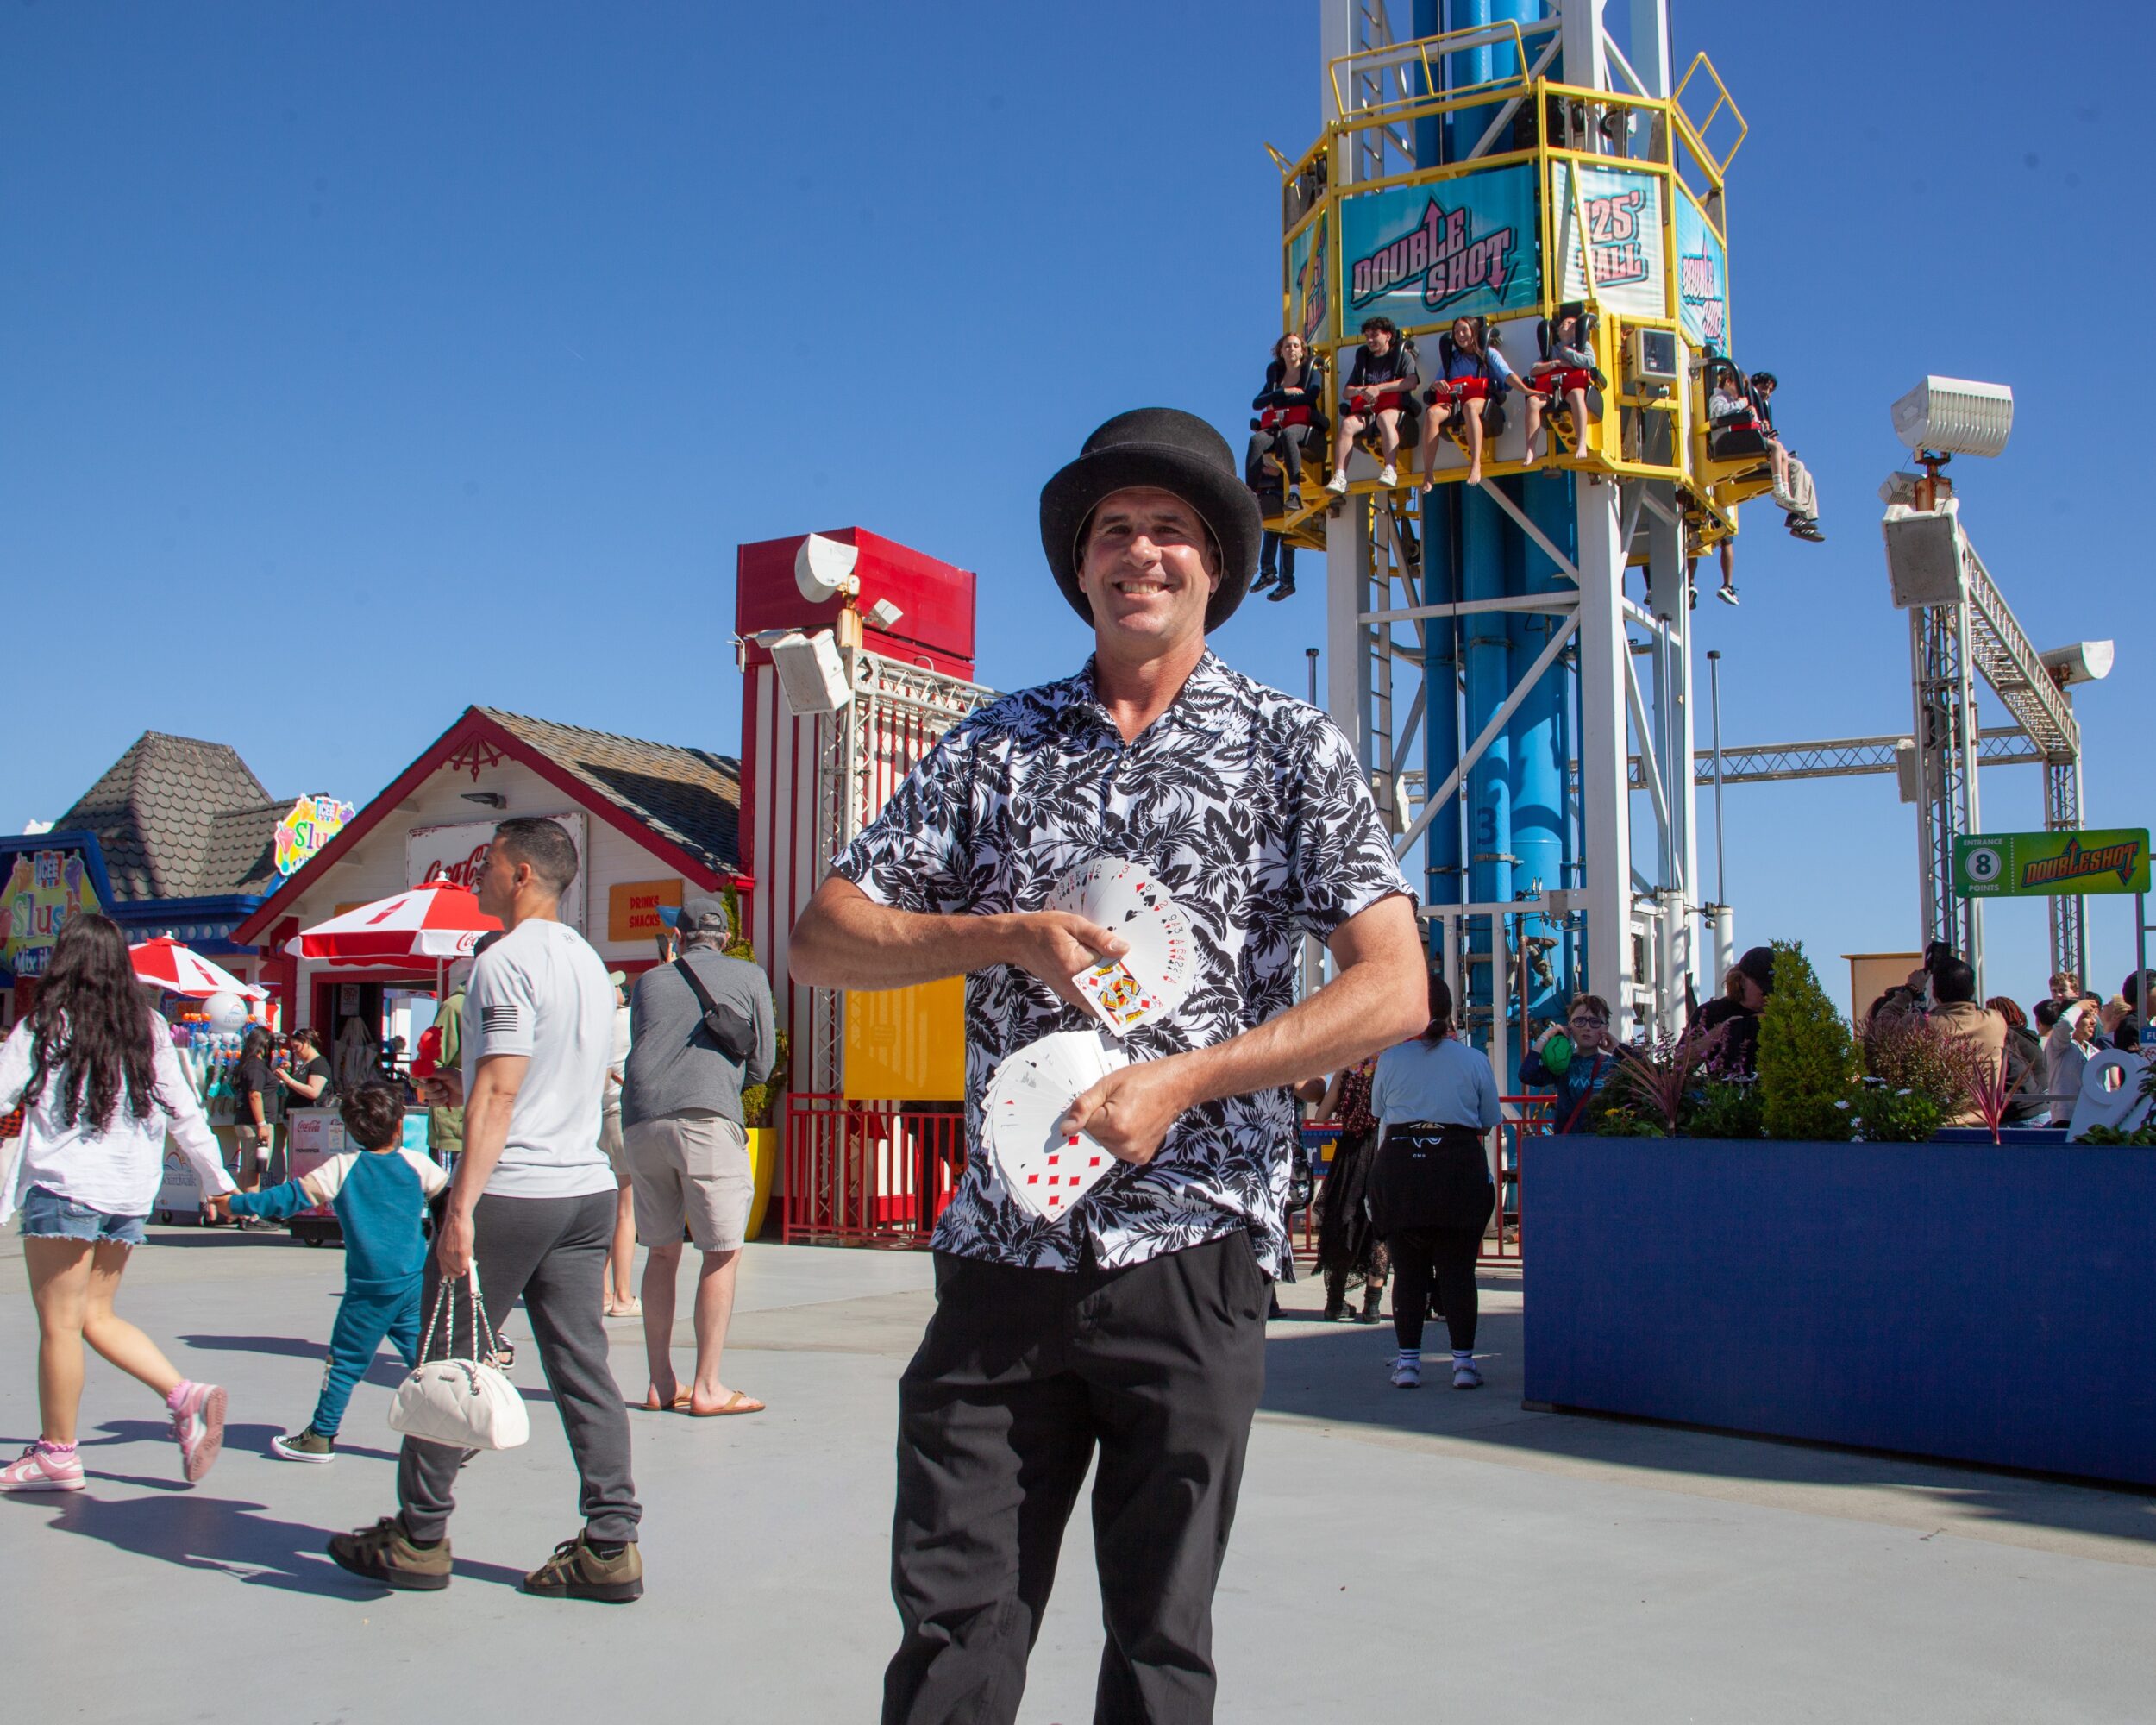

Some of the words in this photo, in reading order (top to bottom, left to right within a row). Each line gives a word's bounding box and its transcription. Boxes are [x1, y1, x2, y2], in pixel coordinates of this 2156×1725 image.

[1351, 198, 1468, 304] DOUBLE
[1423, 226, 1514, 304] SHOT
[1683, 239, 1714, 299] DOUBLE
[1702, 299, 1724, 352] SHOT
[295, 821, 335, 850] Slu
[1095, 863, 1102, 874] 2
[1121, 864, 1131, 875] 3
[1976, 853, 1990, 875] 8
[2022, 837, 2140, 887] DOUBLESHOT
[1145, 883, 1155, 892] 6
[630, 895, 660, 910] DRINKS
[1158, 900, 1169, 910] 2
[629, 913, 661, 928] SNACKS
[1168, 913, 1178, 922] 9
[1174, 926, 1184, 935] 3
[15, 945, 36, 973] Mix
